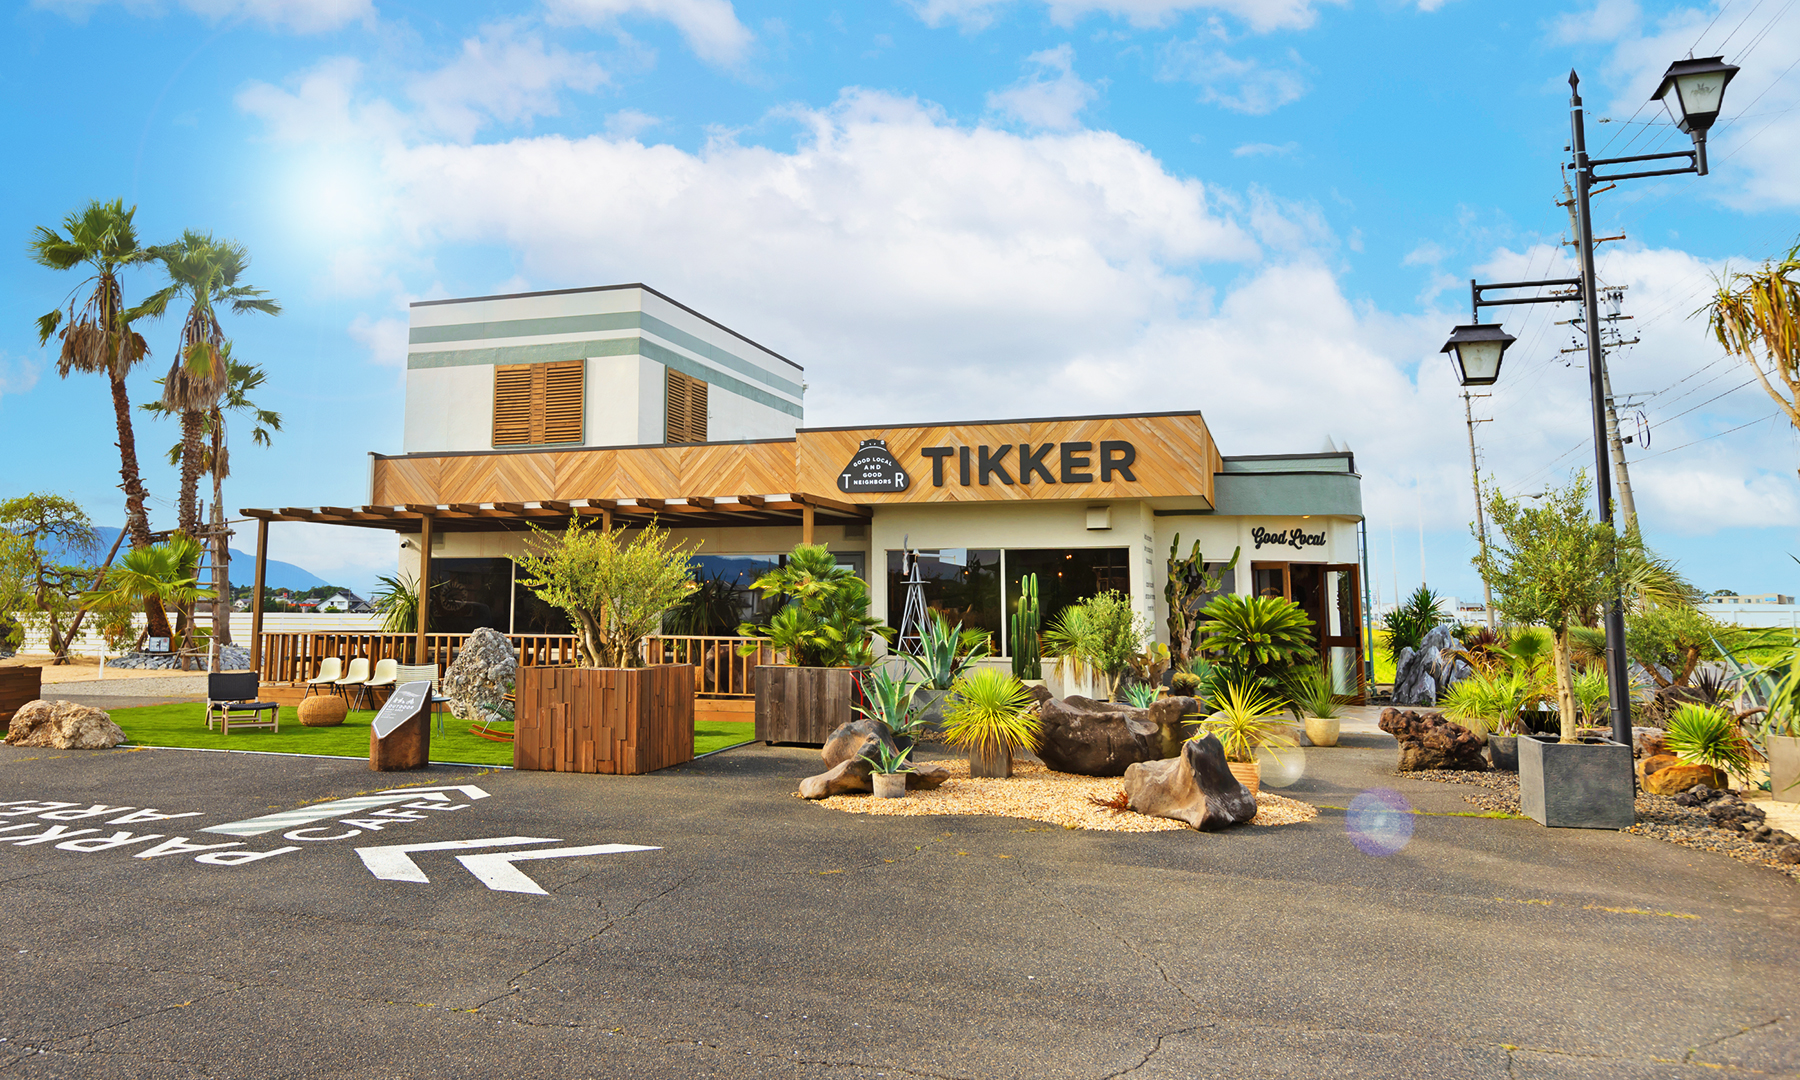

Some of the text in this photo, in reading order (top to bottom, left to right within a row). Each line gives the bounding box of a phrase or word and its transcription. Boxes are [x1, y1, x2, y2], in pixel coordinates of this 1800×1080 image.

[853, 457, 892, 467] GOOD LOCAL
[921, 440, 1137, 487] TIKKER
[842, 473, 852, 489] T
[894, 472, 905, 488] R
[1251, 526, 1327, 550] Good Local
[282, 801, 471, 841] CAFE
[0, 820, 303, 866] PARK
